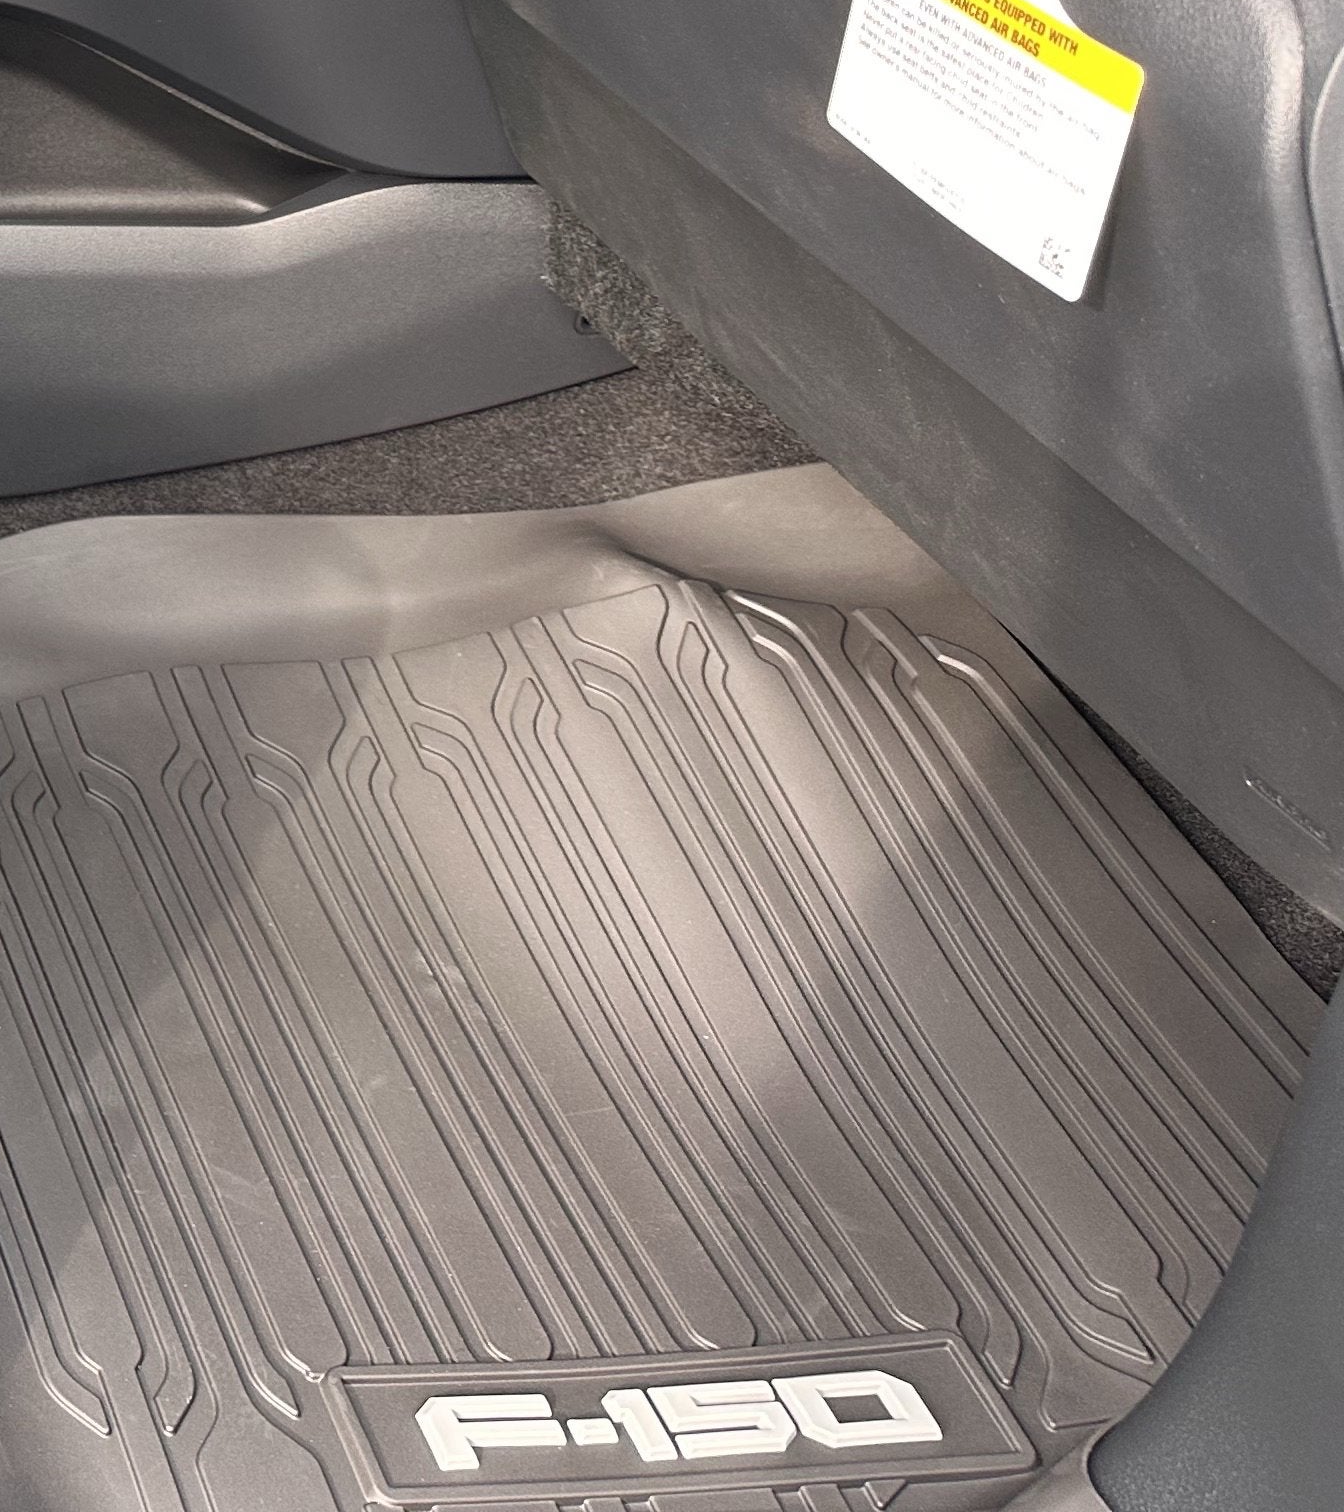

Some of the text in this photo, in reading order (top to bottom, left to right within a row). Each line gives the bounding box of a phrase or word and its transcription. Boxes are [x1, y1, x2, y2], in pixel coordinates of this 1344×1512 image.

[919, 0, 938, 18] EVEN
[941, 13, 960, 32] WITH
[962, 27, 1004, 61] ADVANCED
[1007, 56, 1020, 71] AIR
[990, 17, 1009, 39] AIR
[1010, 29, 1041, 57] BAGS
[1049, 28, 1079, 56] WITH
[413, 1369, 943, 1472] F-150
